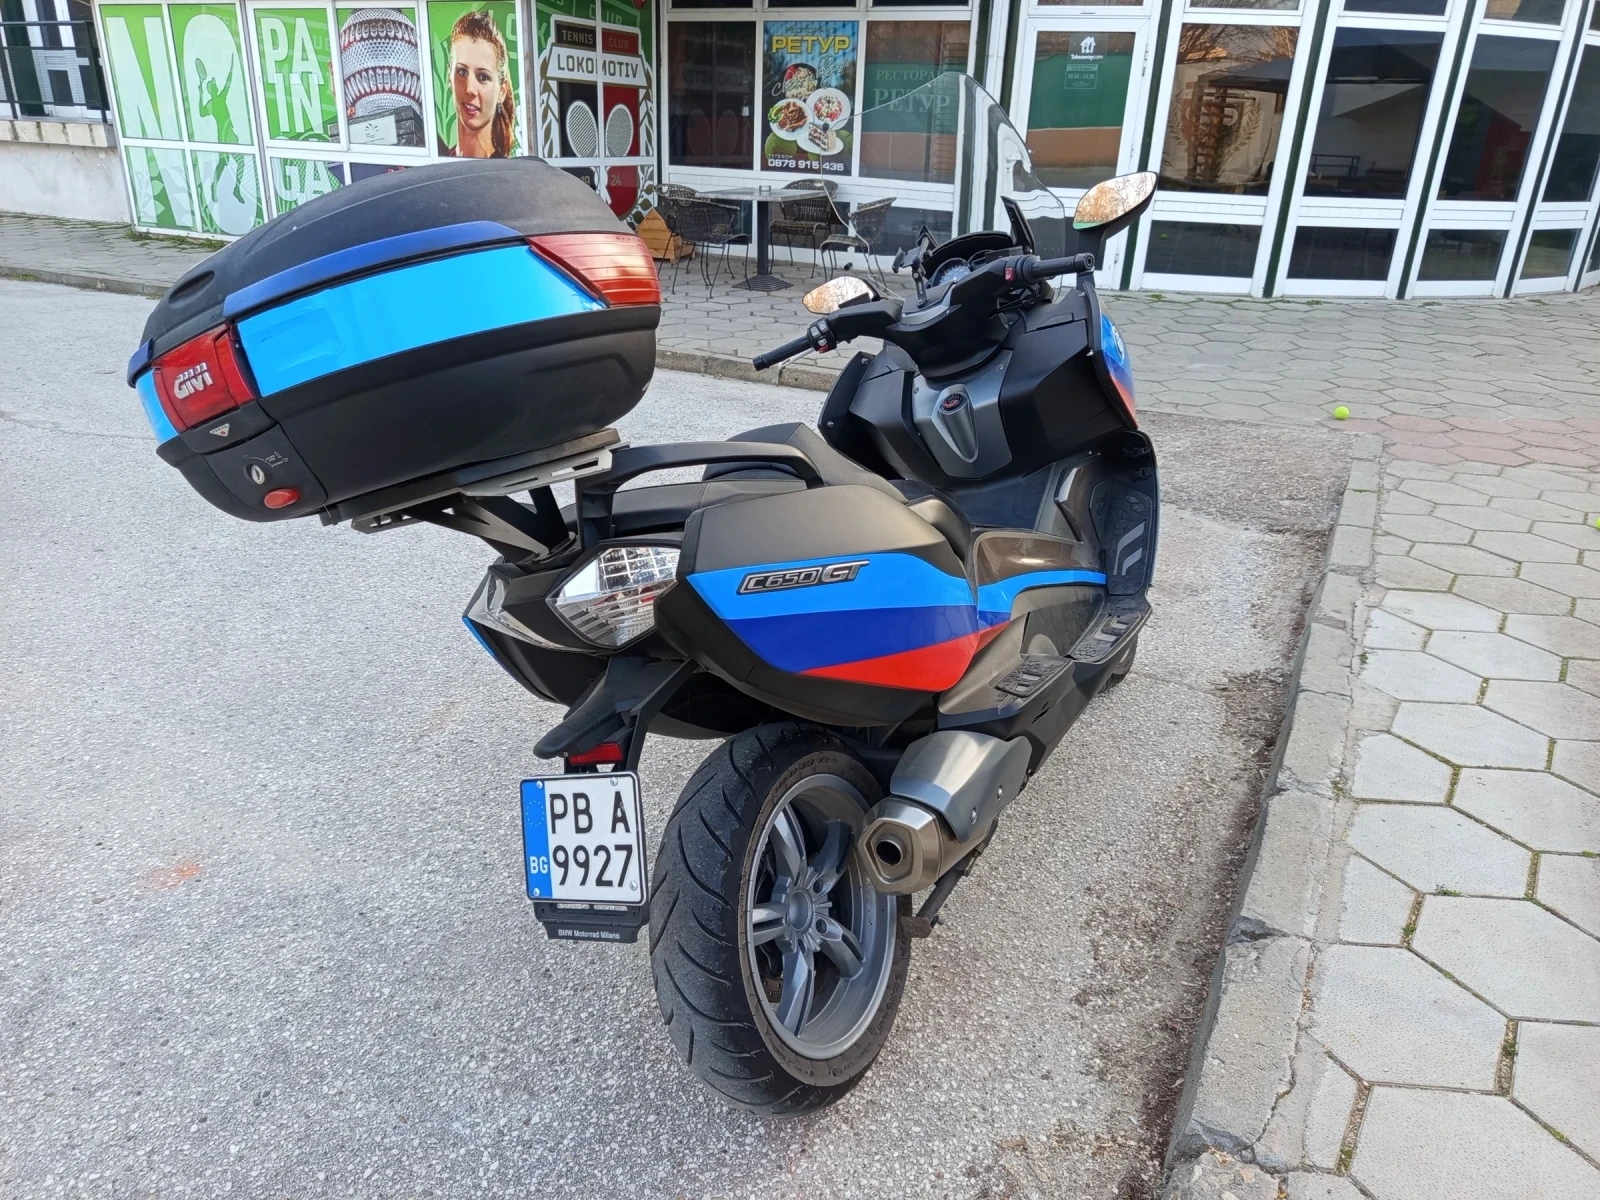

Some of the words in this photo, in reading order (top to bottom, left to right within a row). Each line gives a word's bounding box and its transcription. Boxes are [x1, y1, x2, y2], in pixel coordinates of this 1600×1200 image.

[260, 17, 324, 85] PA
[561, 30, 593, 45] TENNIS
[608, 37, 629, 49] CLUB
[771, 35, 850, 54] РЕТУР
[557, 53, 639, 79] LOKOMOTIV
[273, 73, 324, 134] IN
[873, 88, 950, 114] РЕТУР
[768, 158, 796, 168] 0878
[798, 160, 819, 169] 915
[822, 162, 844, 171] 435
[610, 174, 622, 187] 24
[173, 363, 214, 400] GIVI
[549, 792, 594, 835] PB
[610, 790, 631, 834] A
[529, 856, 548, 874] BG
[552, 844, 633, 888] 9927
[558, 929, 573, 937] BMW
[573, 930, 600, 939] Motorrad
[600, 931, 620, 940] Milano
